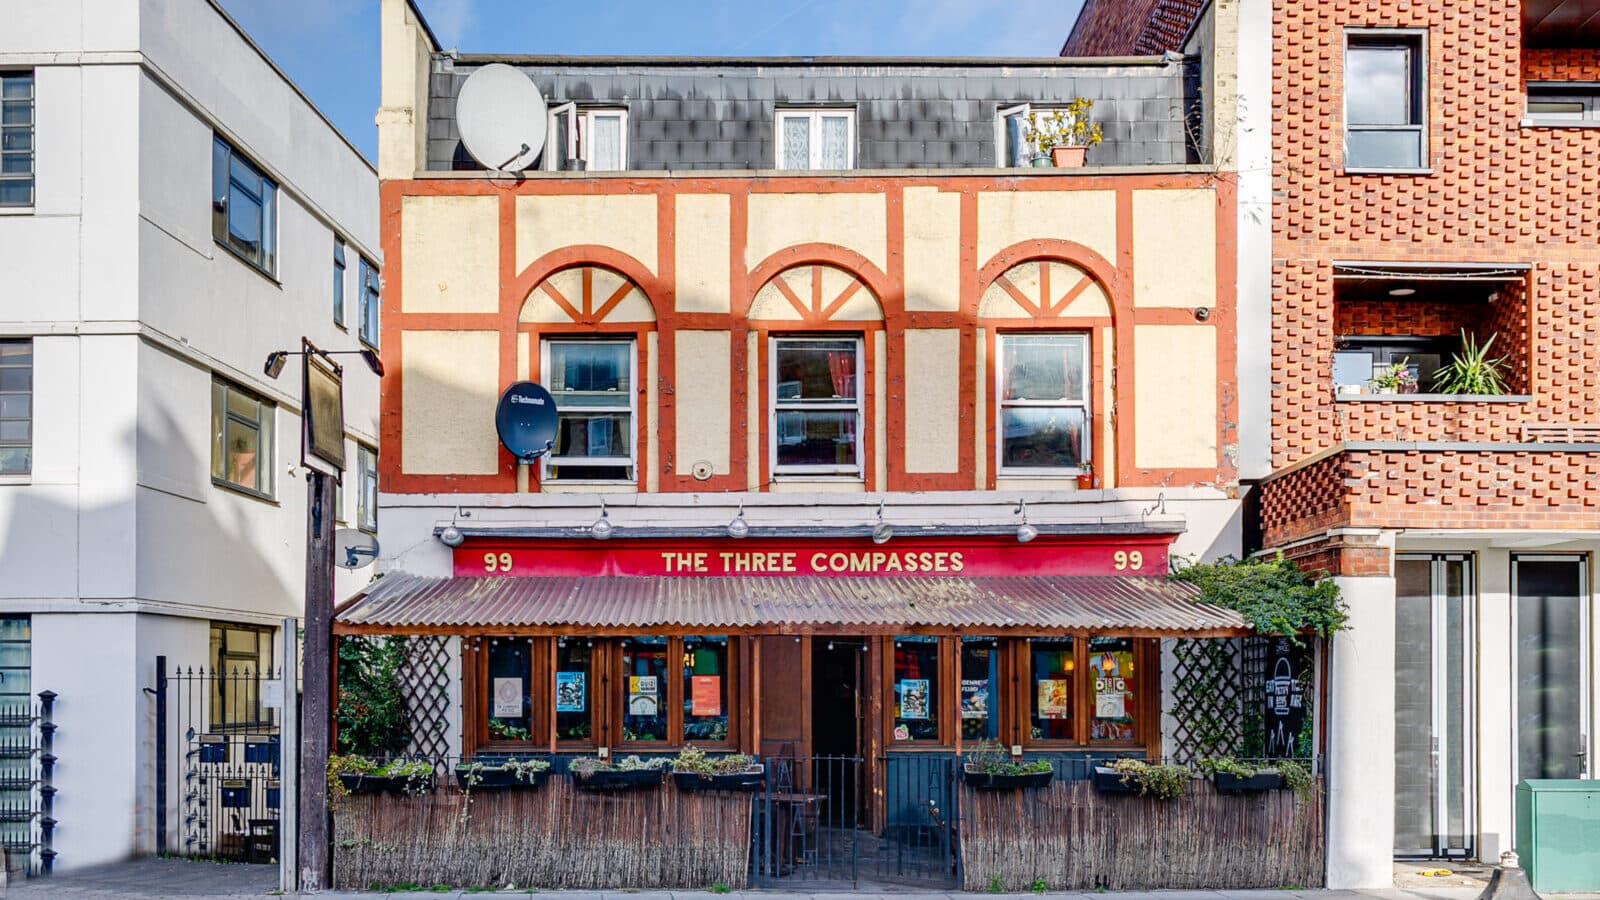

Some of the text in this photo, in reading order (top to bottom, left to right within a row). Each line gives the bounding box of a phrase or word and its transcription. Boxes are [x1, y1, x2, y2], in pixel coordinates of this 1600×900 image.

[483, 552, 513, 572] 99
[661, 552, 964, 572] THE THREE COMPASSES
[1113, 550, 1143, 570] 99
